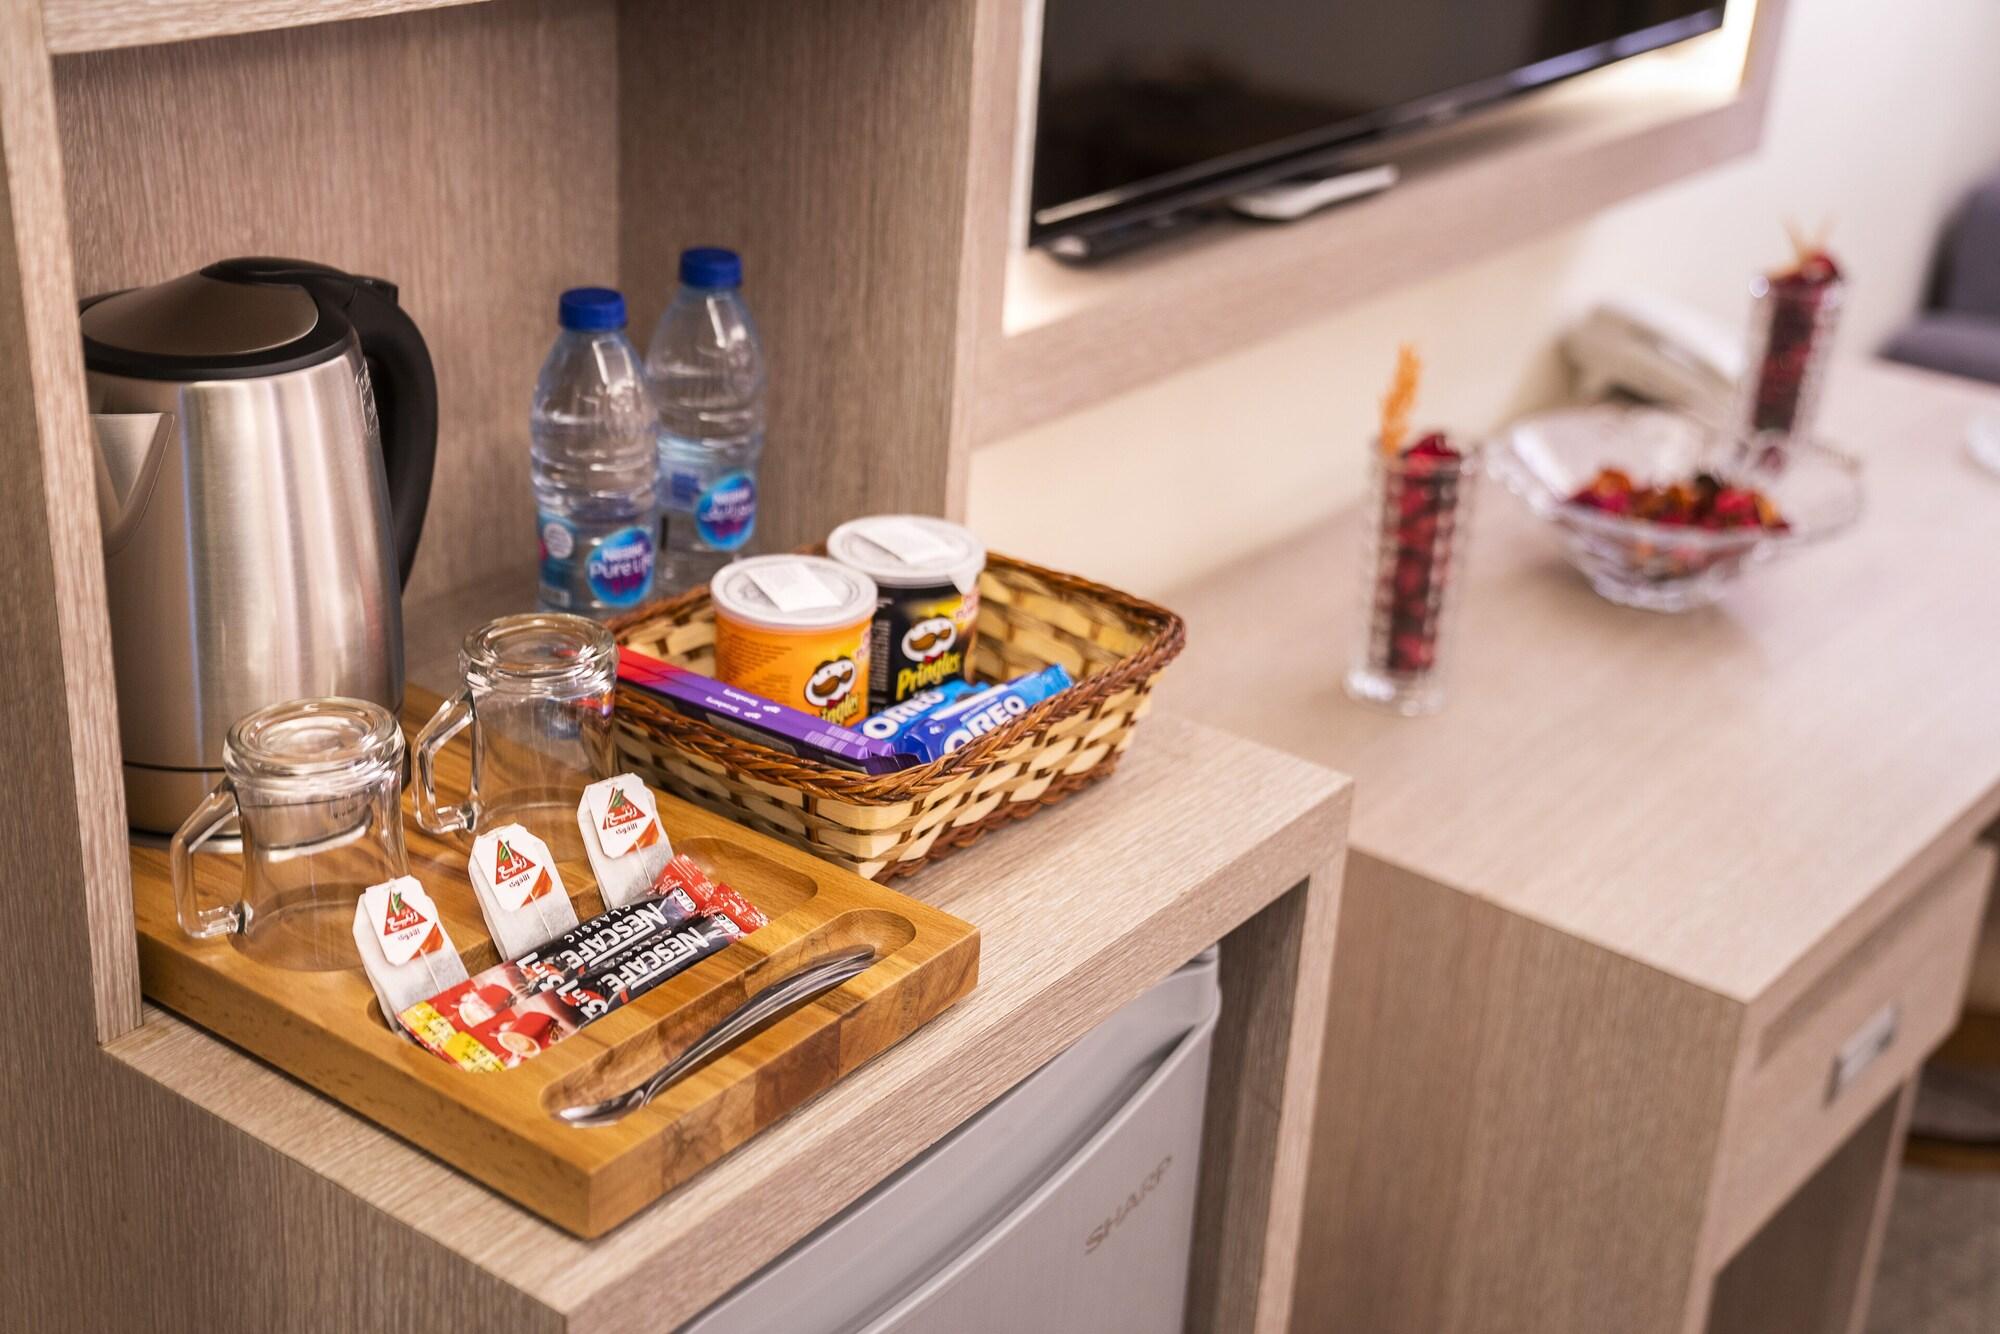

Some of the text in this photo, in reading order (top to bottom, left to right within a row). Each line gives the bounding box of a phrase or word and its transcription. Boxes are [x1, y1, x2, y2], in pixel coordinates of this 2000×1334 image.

[896, 652, 960, 701] Pringles
[943, 694, 1027, 755] OREO
[564, 904, 631, 943] CLASSIC
[1084, 1154, 1174, 1255] SHARP
